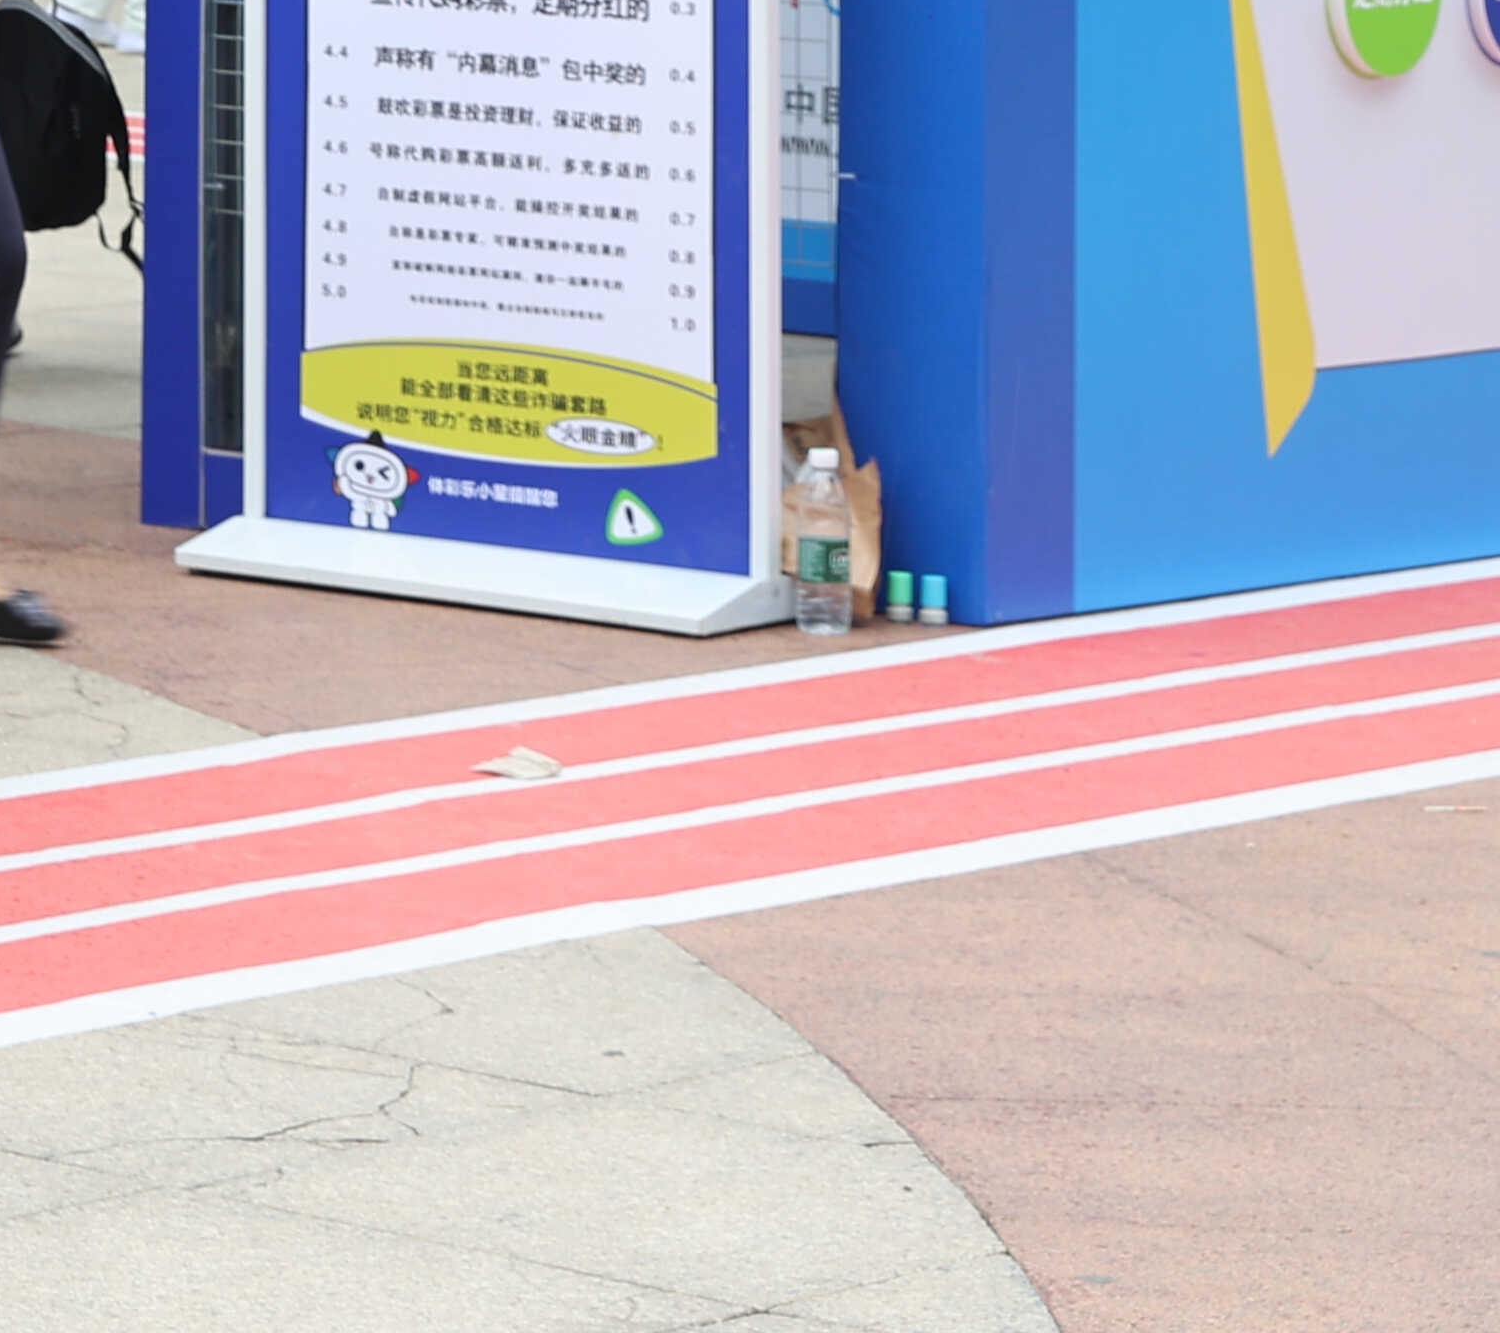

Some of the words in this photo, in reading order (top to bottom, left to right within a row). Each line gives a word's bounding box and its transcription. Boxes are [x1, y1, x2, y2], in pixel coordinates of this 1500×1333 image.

[669, 1, 696, 15] 0.3
[325, 45, 349, 59] 4.4
[669, 69, 695, 82] 0.4
[325, 95, 348, 108] 4.5
[669, 122, 696, 135] 0.5
[671, 318, 695, 331] 1.0
